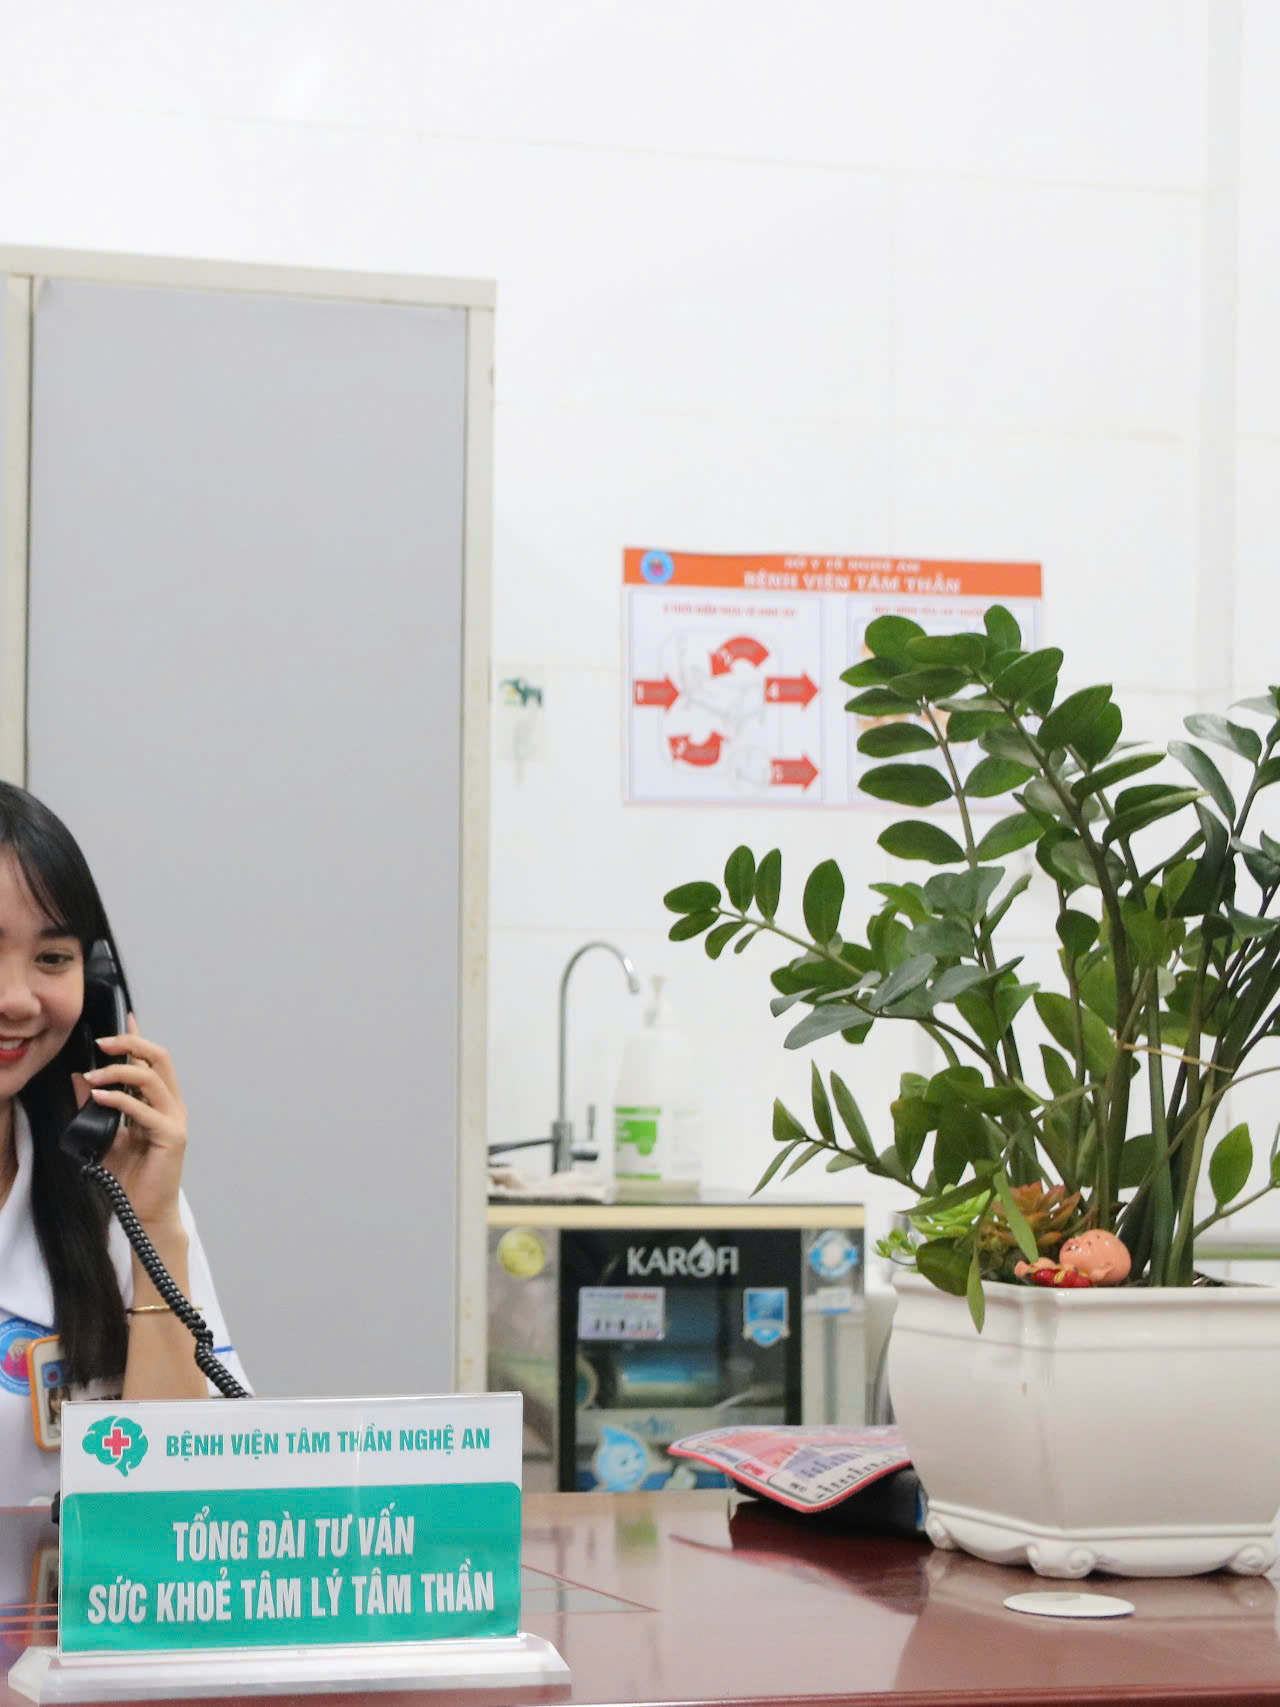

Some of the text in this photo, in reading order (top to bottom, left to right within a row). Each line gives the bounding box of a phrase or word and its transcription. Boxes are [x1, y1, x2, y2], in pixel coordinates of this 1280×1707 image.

[627, 1237, 739, 1278] KAROFI
[166, 1421, 491, 1462] BỆNH VIỆN TÂM THẦN NGHỆ AN
[172, 1502, 415, 1562] TỔNG ĐÀI TƯ VẤN
[87, 1557, 495, 1624] SỨC KHOẺ TÂM LÝ TÂM THẦN
